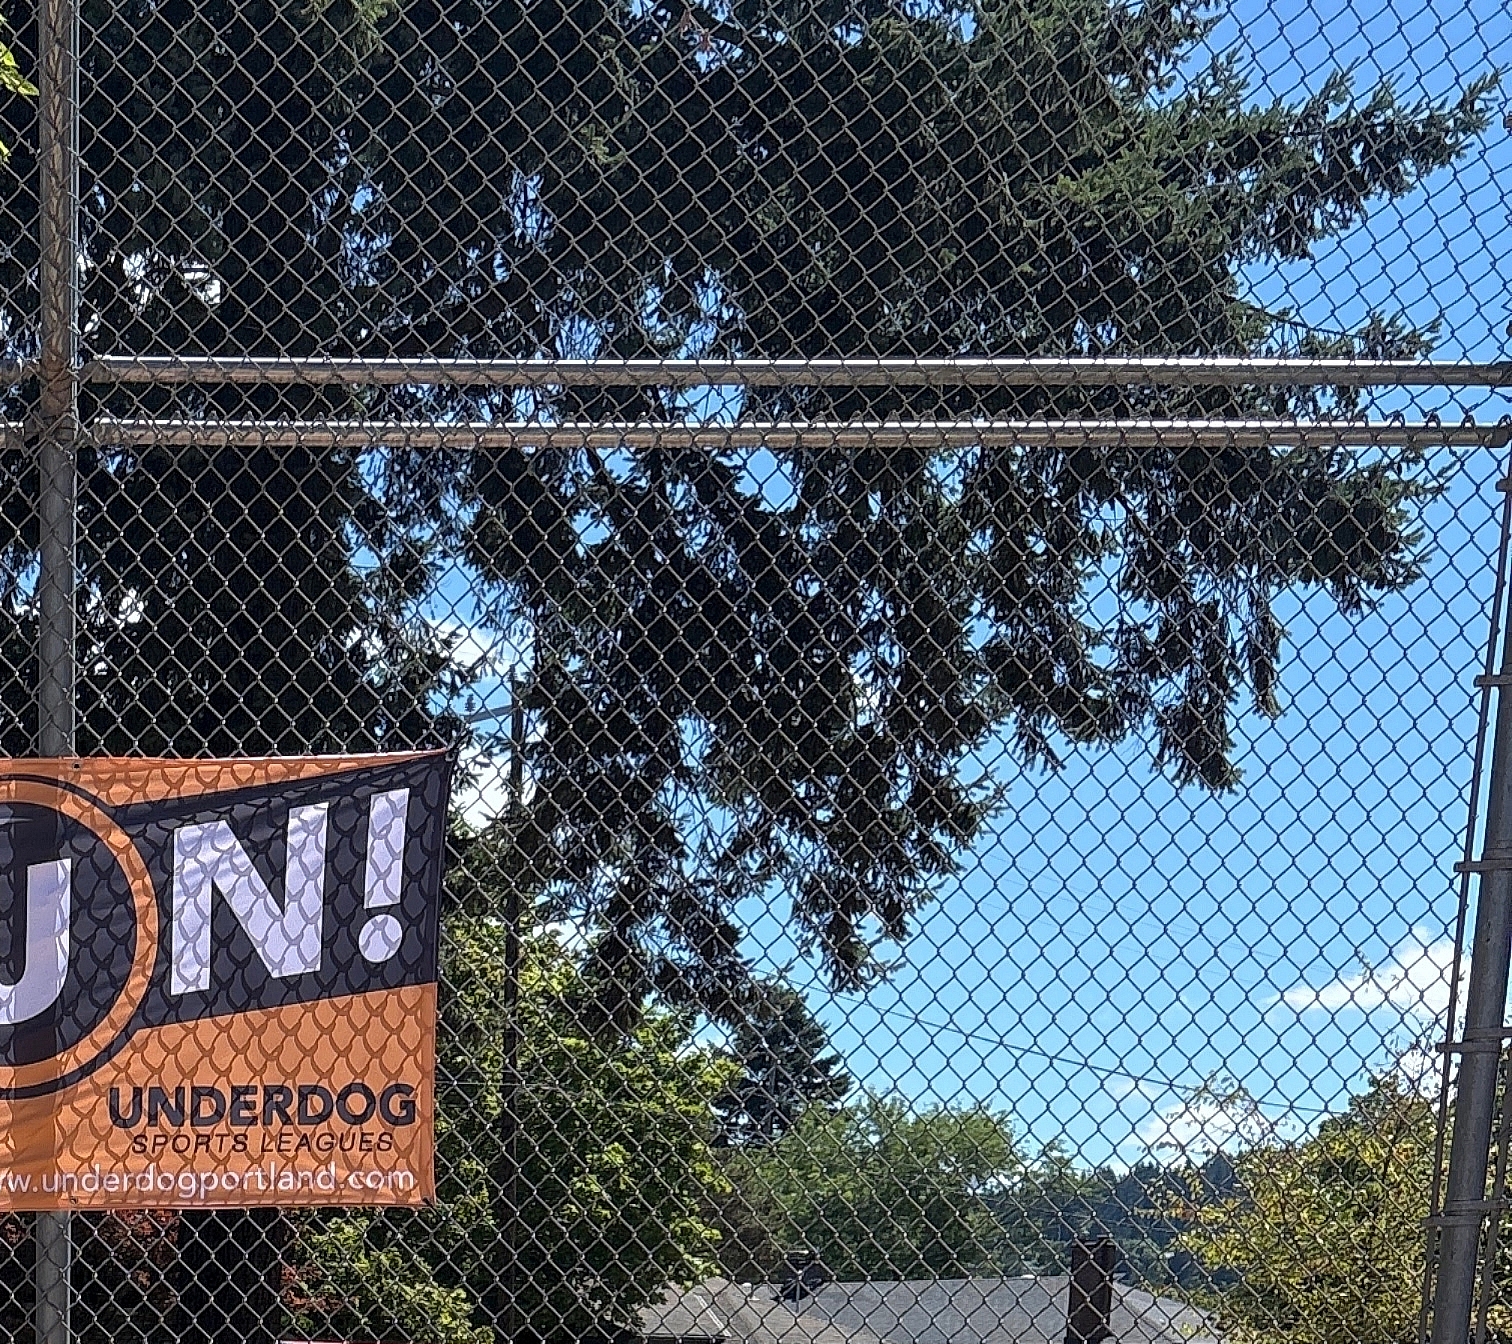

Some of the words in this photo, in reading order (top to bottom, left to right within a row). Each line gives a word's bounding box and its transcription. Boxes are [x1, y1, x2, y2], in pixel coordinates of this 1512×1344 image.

[109, 1083, 416, 1127] UNDERDOG
[132, 1133, 248, 1154] SPORTS
[261, 1132, 393, 1153] LEAGUES
